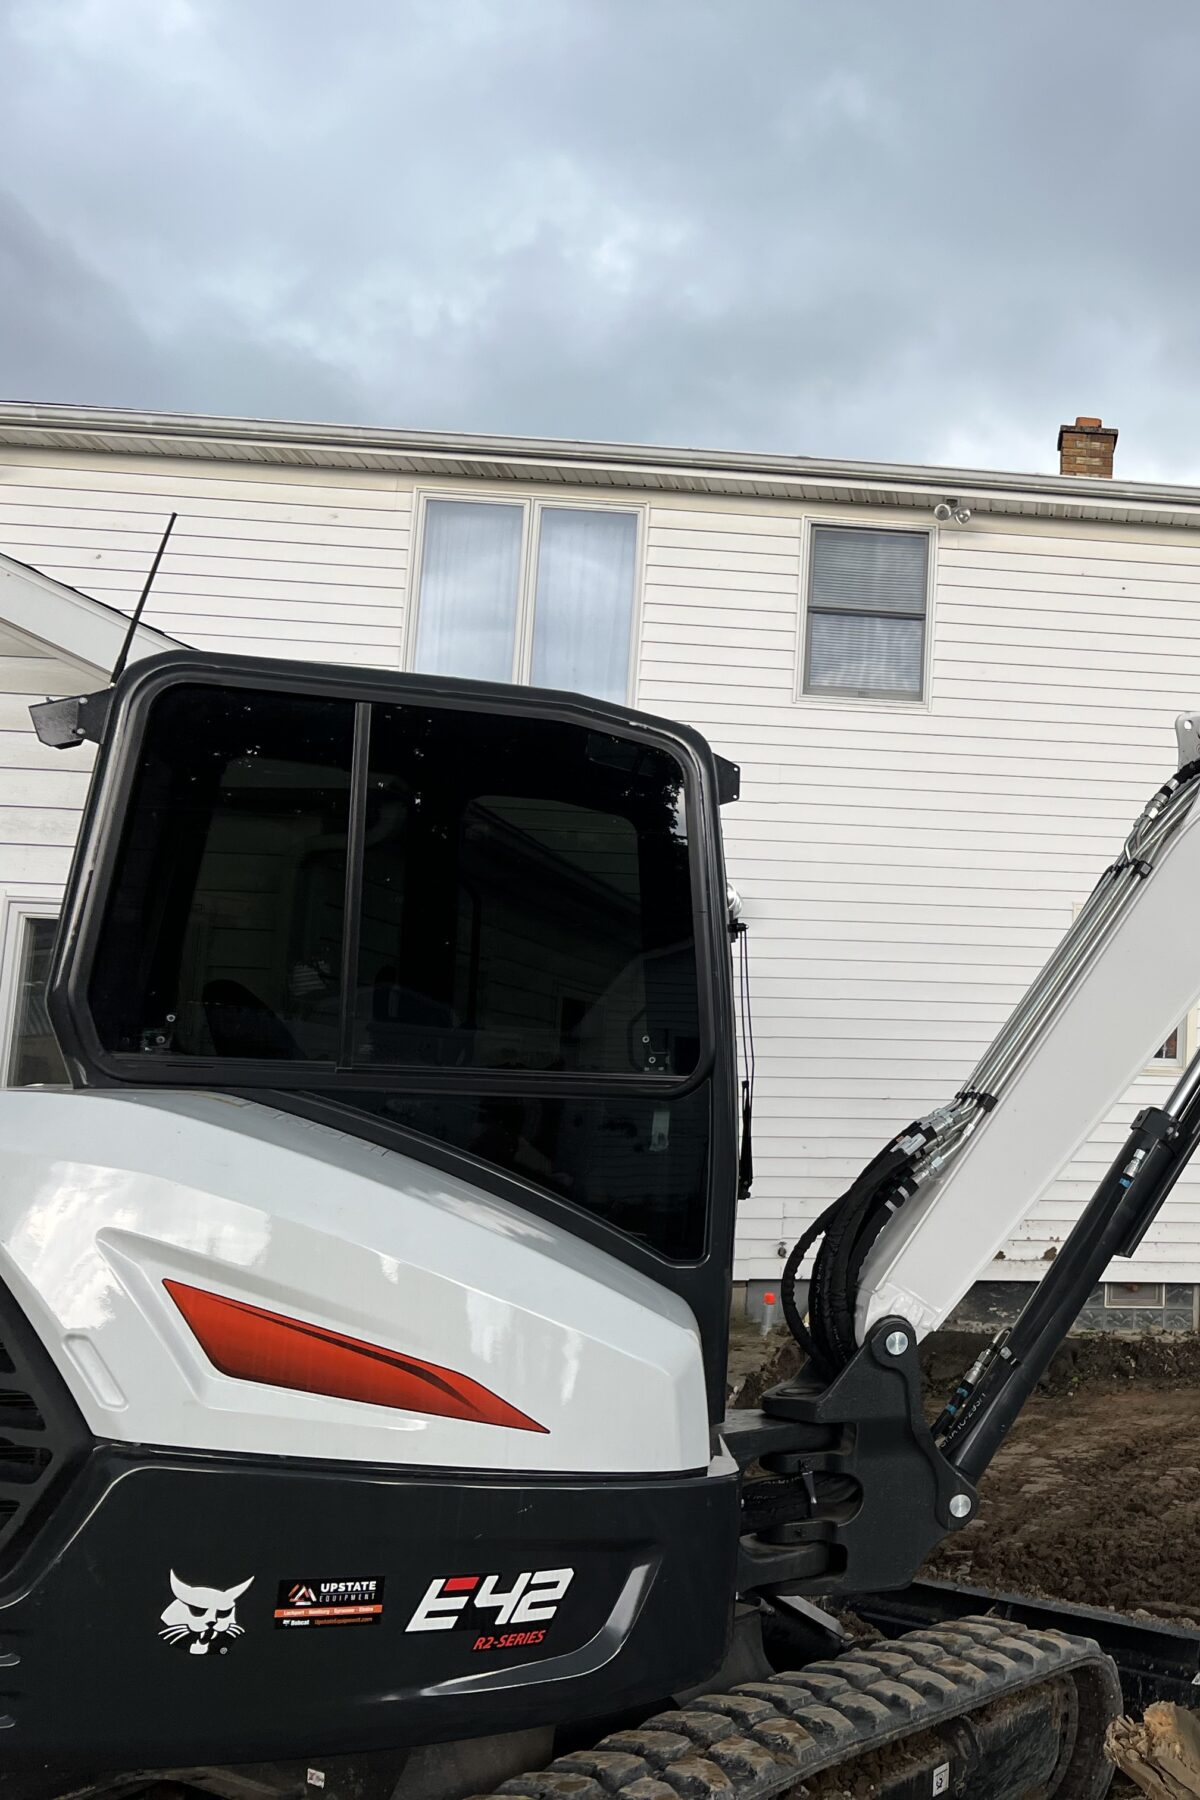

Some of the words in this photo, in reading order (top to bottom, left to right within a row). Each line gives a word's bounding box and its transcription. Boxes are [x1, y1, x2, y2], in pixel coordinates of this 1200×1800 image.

[321, 1581, 377, 1592] UPSTATE
[319, 1592, 375, 1603] EQUIPMENT
[405, 1568, 575, 1633] E42
[473, 1630, 546, 1650] R2-SERIES
